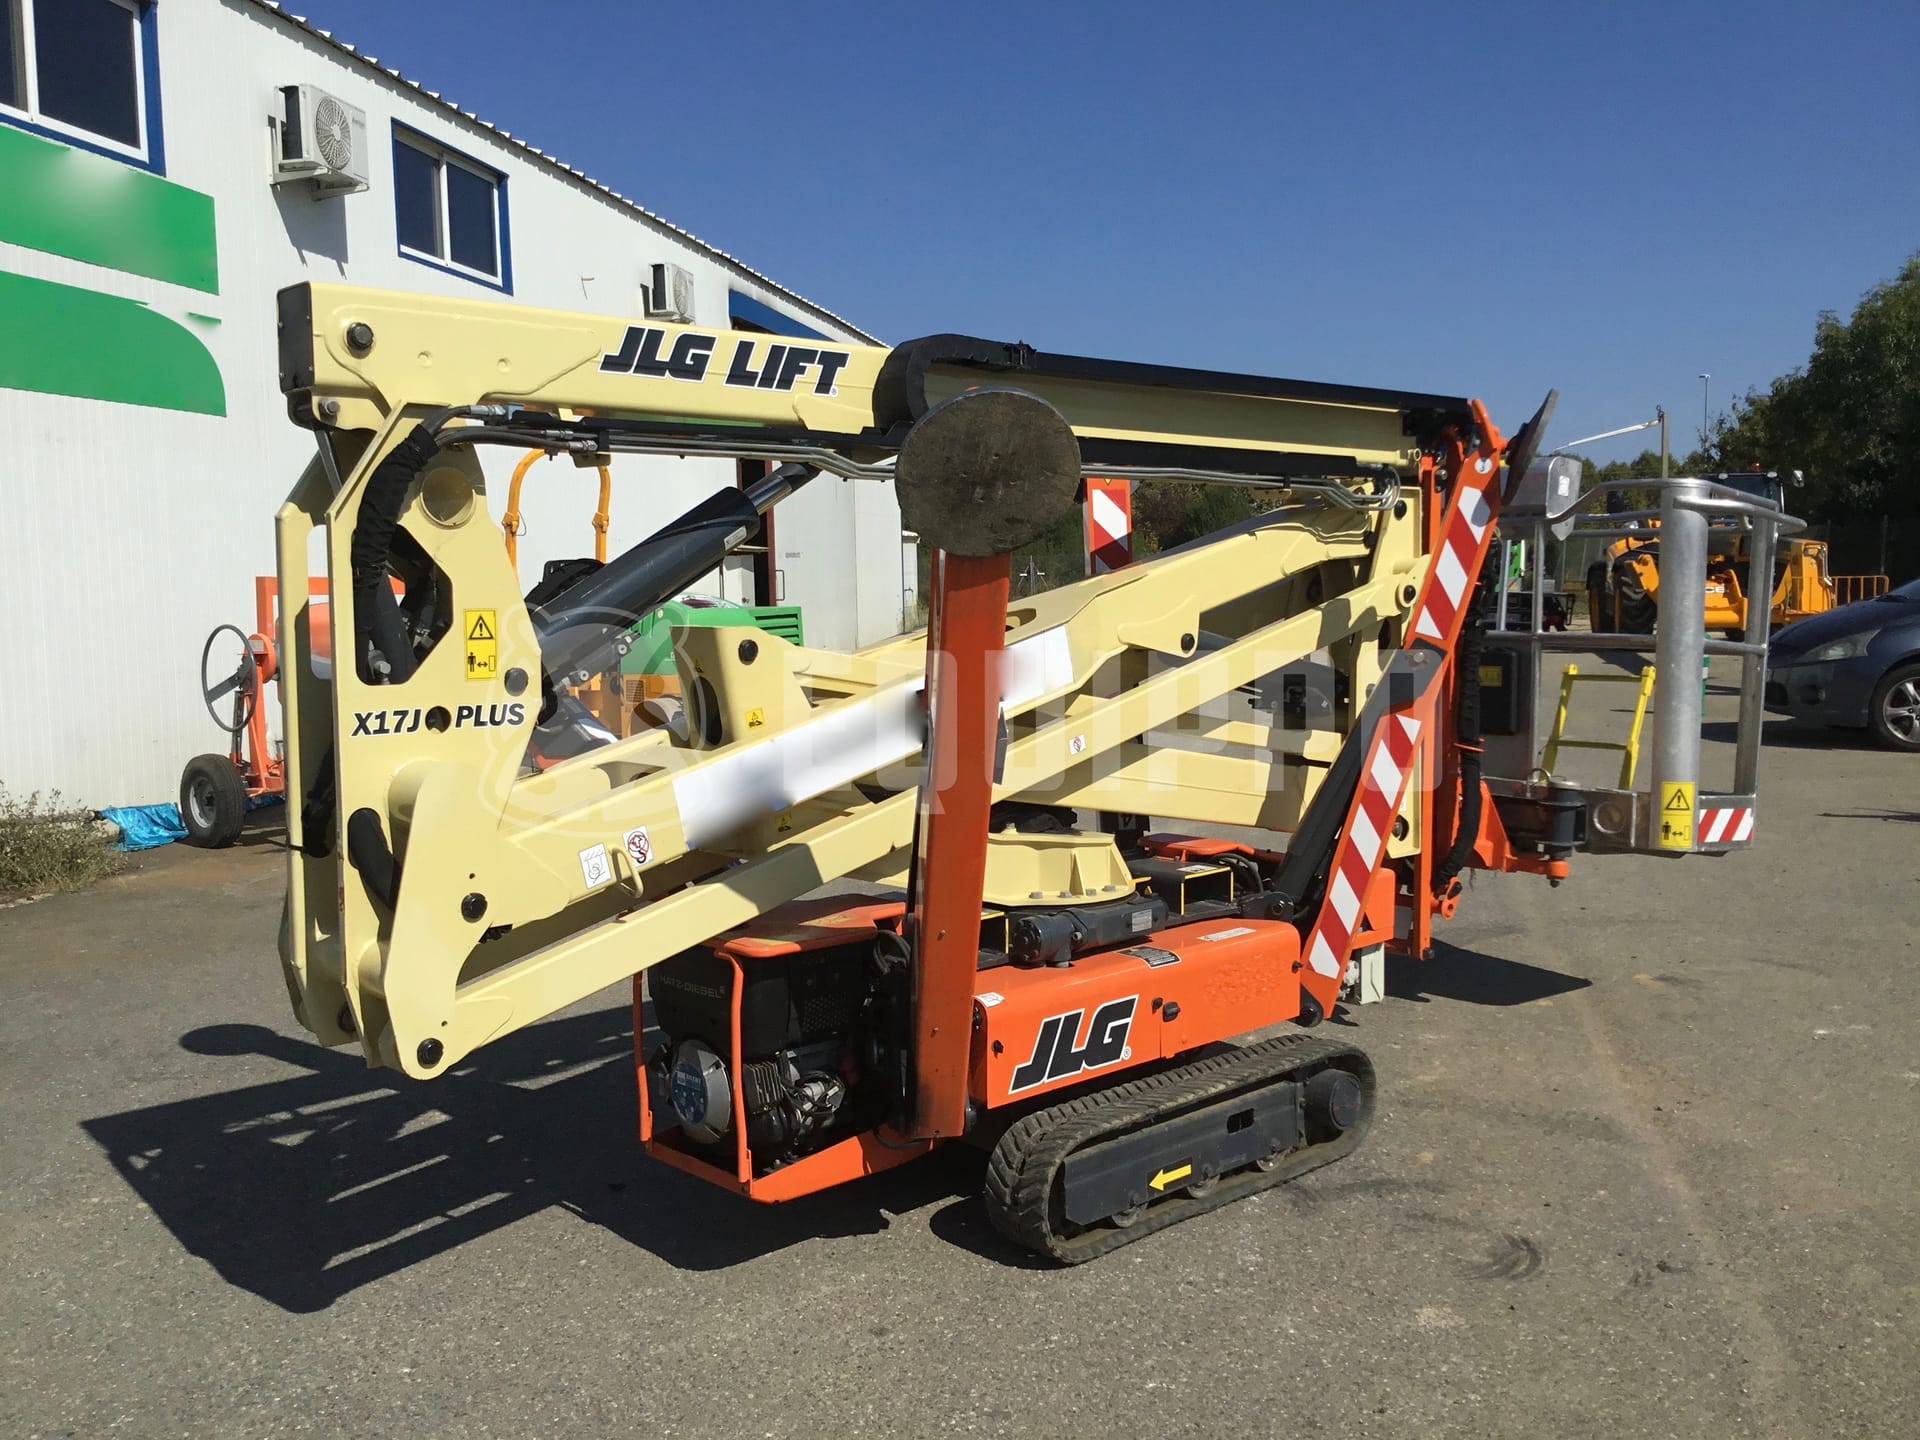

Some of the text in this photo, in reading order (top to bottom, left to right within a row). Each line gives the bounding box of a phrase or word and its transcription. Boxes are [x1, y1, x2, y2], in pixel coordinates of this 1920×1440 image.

[599, 325, 850, 394] JLG LIFT
[351, 703, 525, 737] X17J PLUS
[1009, 995, 1139, 1093] JLG
